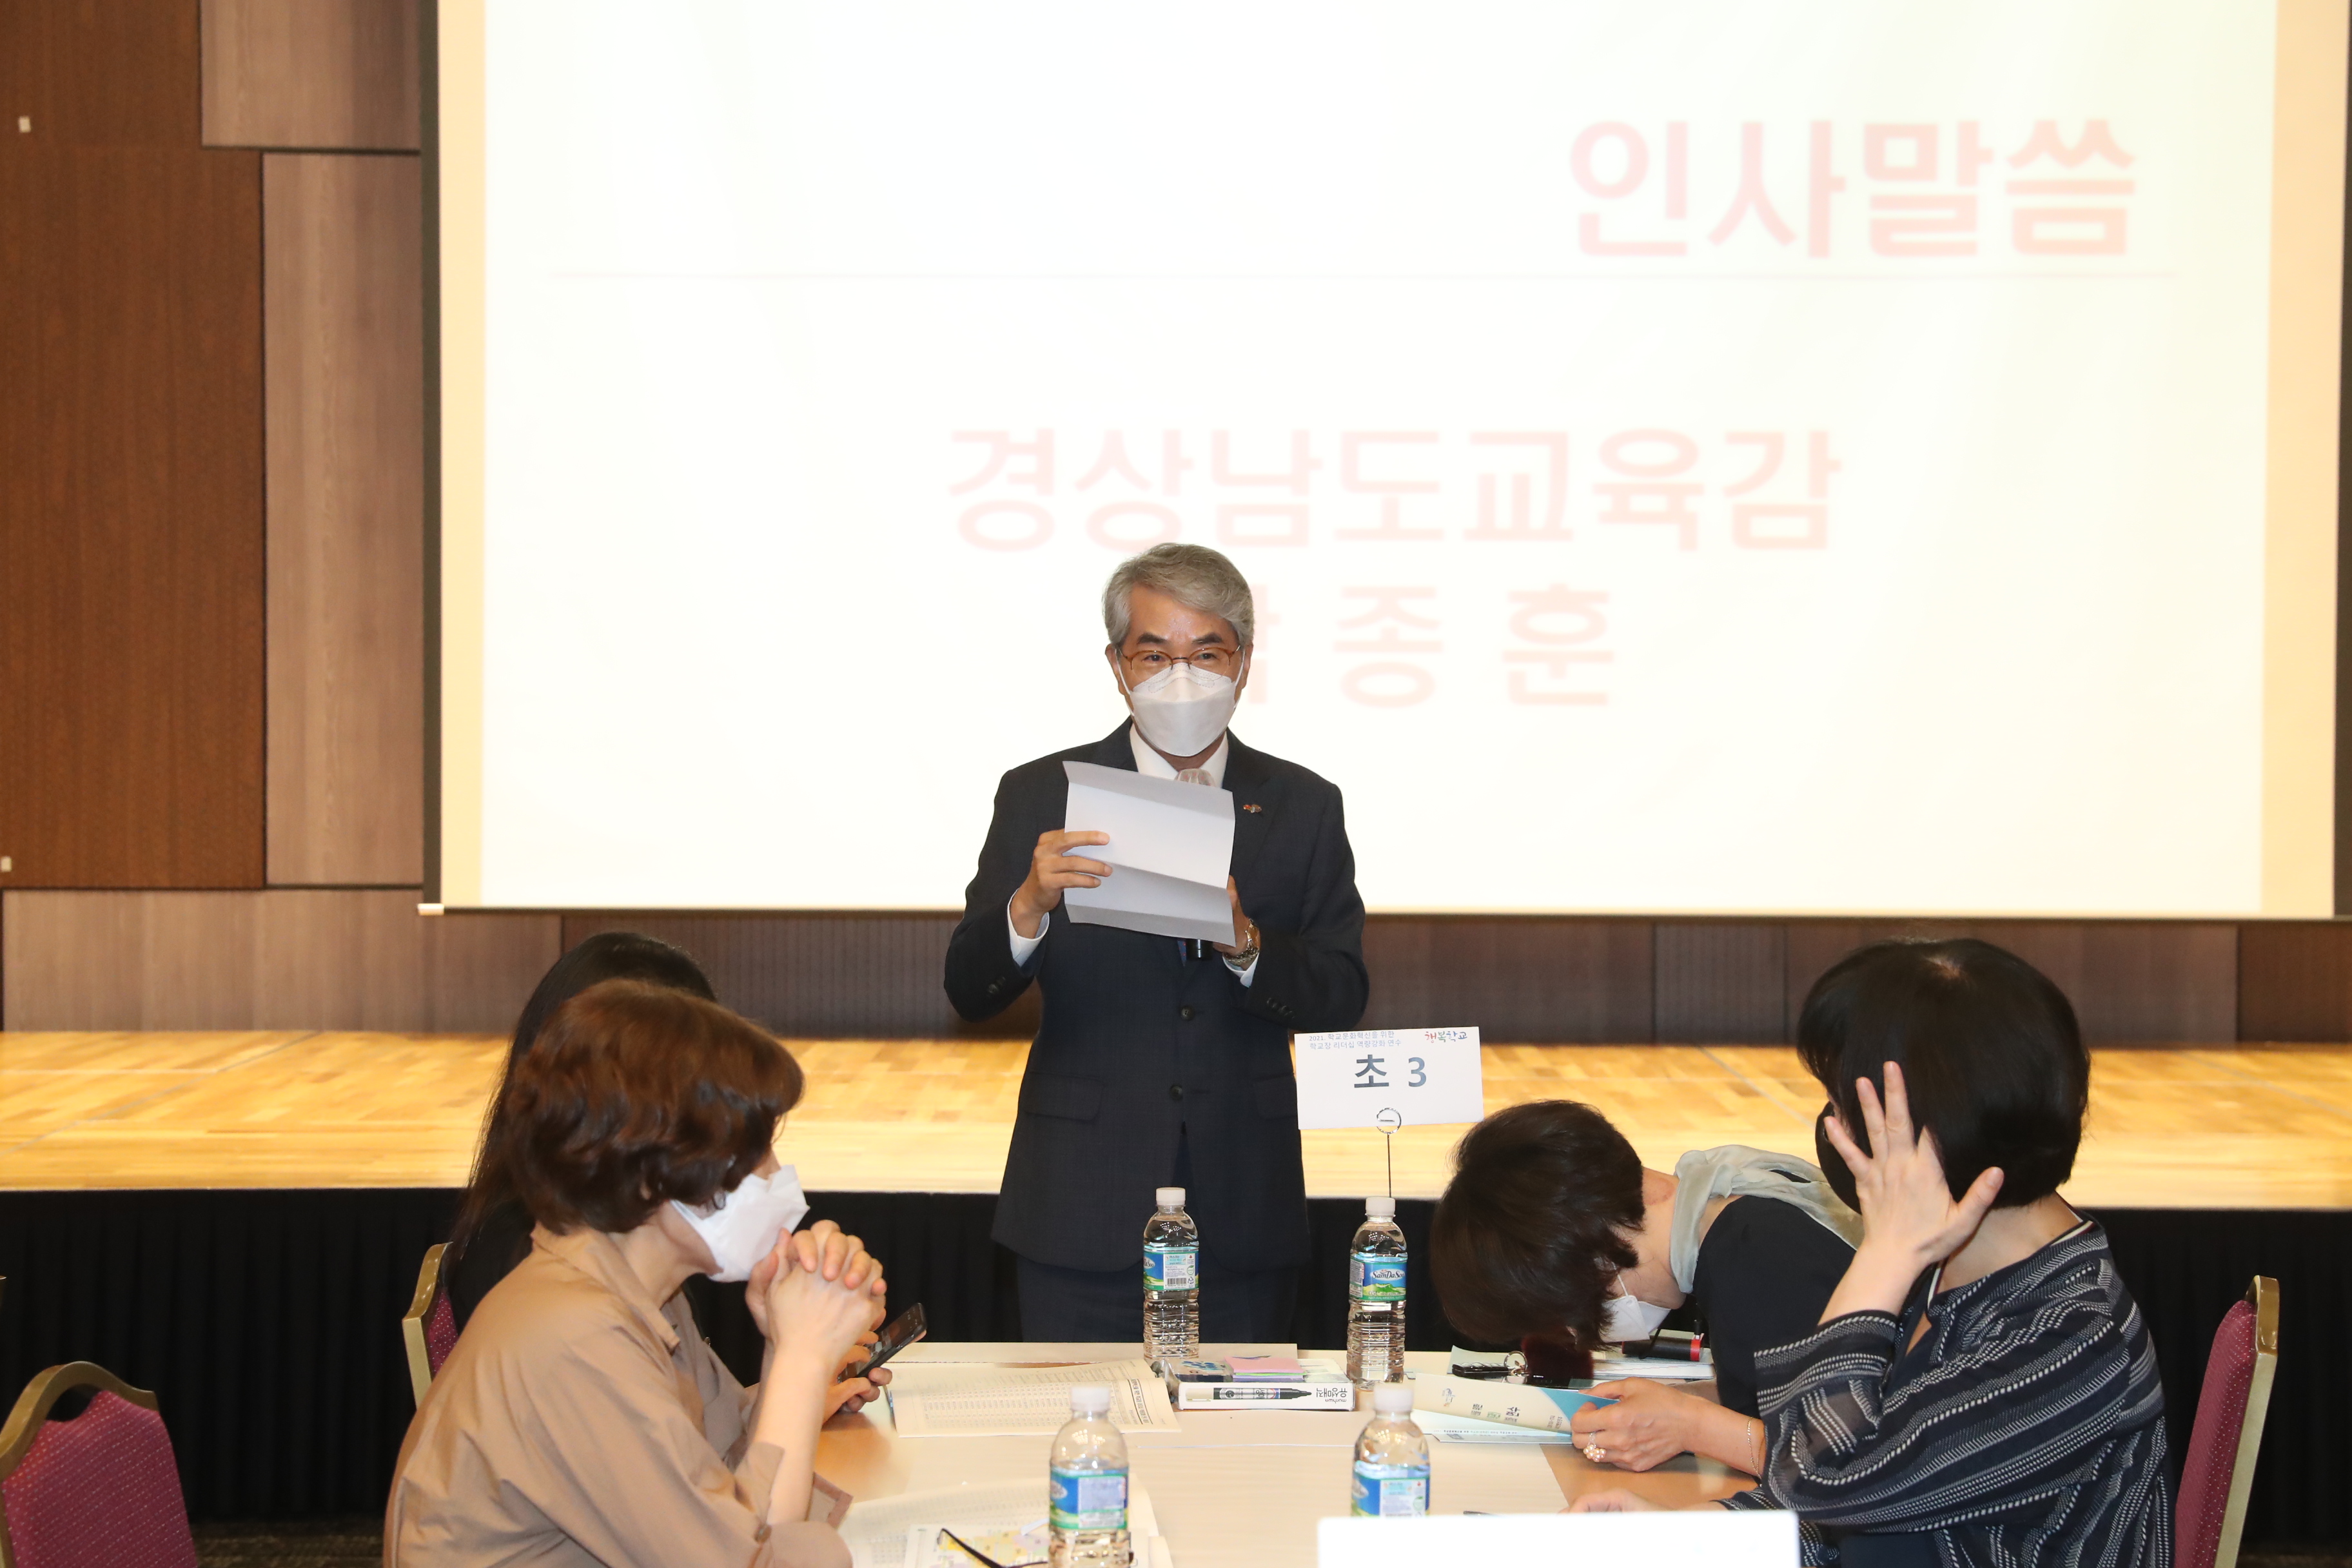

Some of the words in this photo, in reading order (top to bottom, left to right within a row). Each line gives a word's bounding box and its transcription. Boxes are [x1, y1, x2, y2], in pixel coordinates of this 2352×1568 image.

[1569, 119, 2136, 259] 인사말씀
[948, 428, 1843, 553] 경상남도교육감
[1333, 586, 1444, 709] 종
[1502, 583, 1615, 706] 훈
[1328, 1031, 1378, 1041] 학교문화혁신을
[1380, 1030, 1395, 1039] 위한
[1424, 1030, 1468, 1044] 행복학교
[1387, 1039, 1402, 1047] 연수
[1353, 1054, 1389, 1088] 초
[1408, 1056, 1427, 1088] 3
[1372, 1269, 1405, 1279] SamDaSoo
[1316, 1387, 1348, 1398] 유성매직
